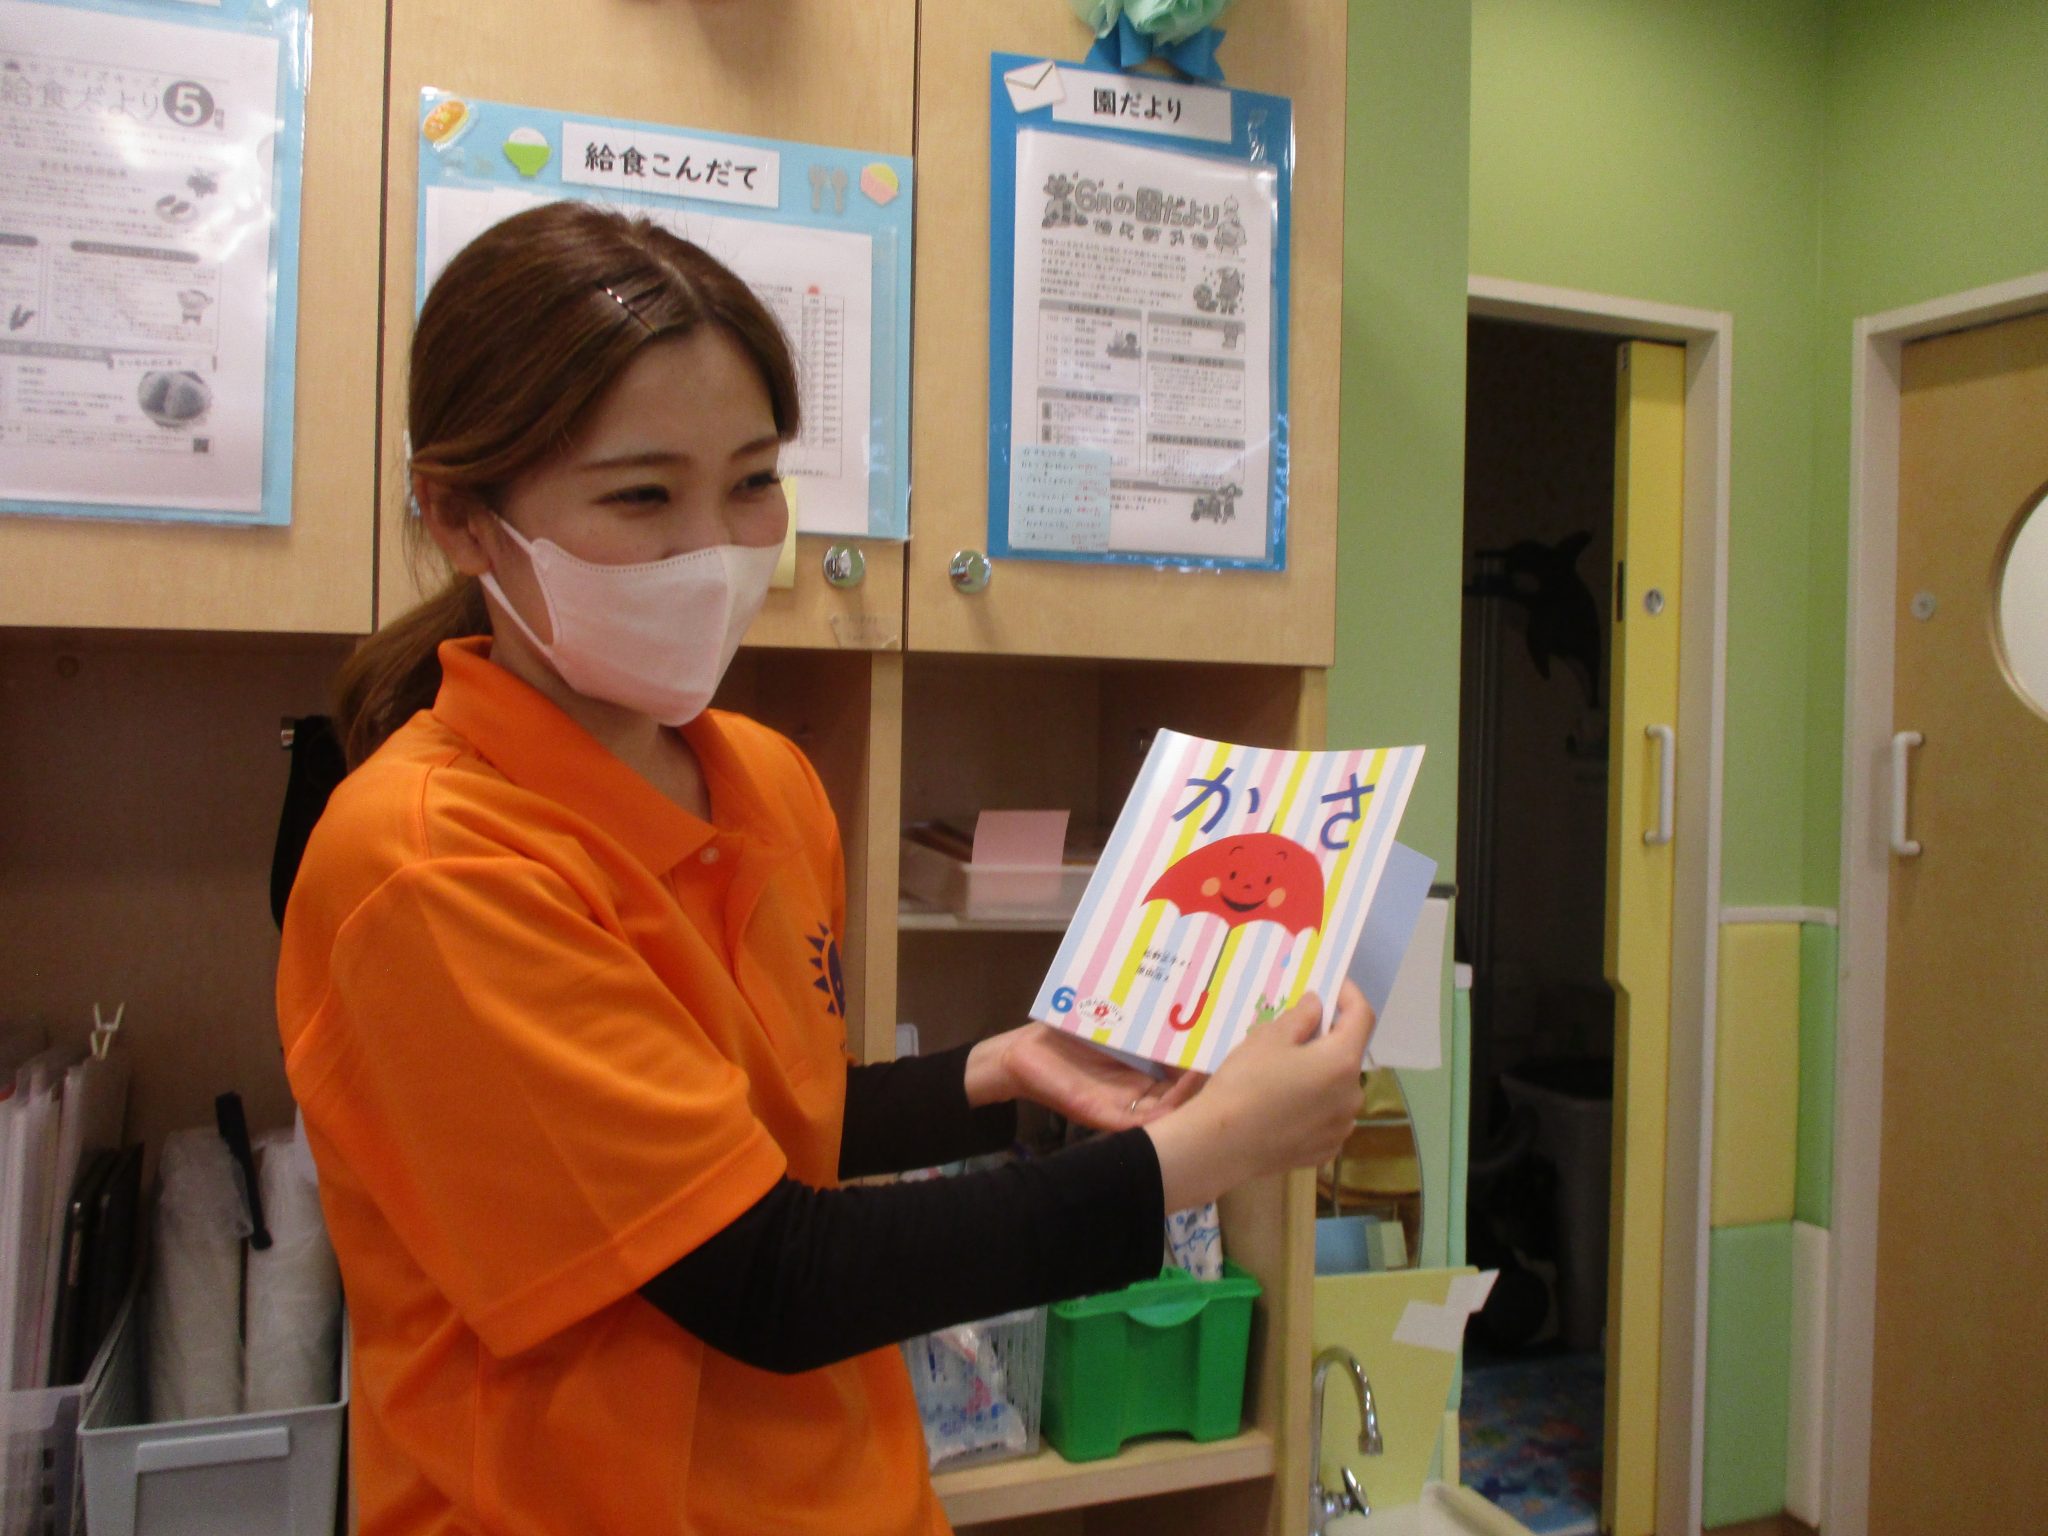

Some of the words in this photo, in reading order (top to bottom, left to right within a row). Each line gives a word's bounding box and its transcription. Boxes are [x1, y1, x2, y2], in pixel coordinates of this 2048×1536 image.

[174, 85, 204, 123] 5
[1093, 88, 1182, 123] 園だより
[585, 141, 759, 190] 給食こんだて
[1074, 178, 1220, 230] 6月の園だより
[1172, 766, 1375, 850] かさ
[1051, 986, 1077, 1013] 6
